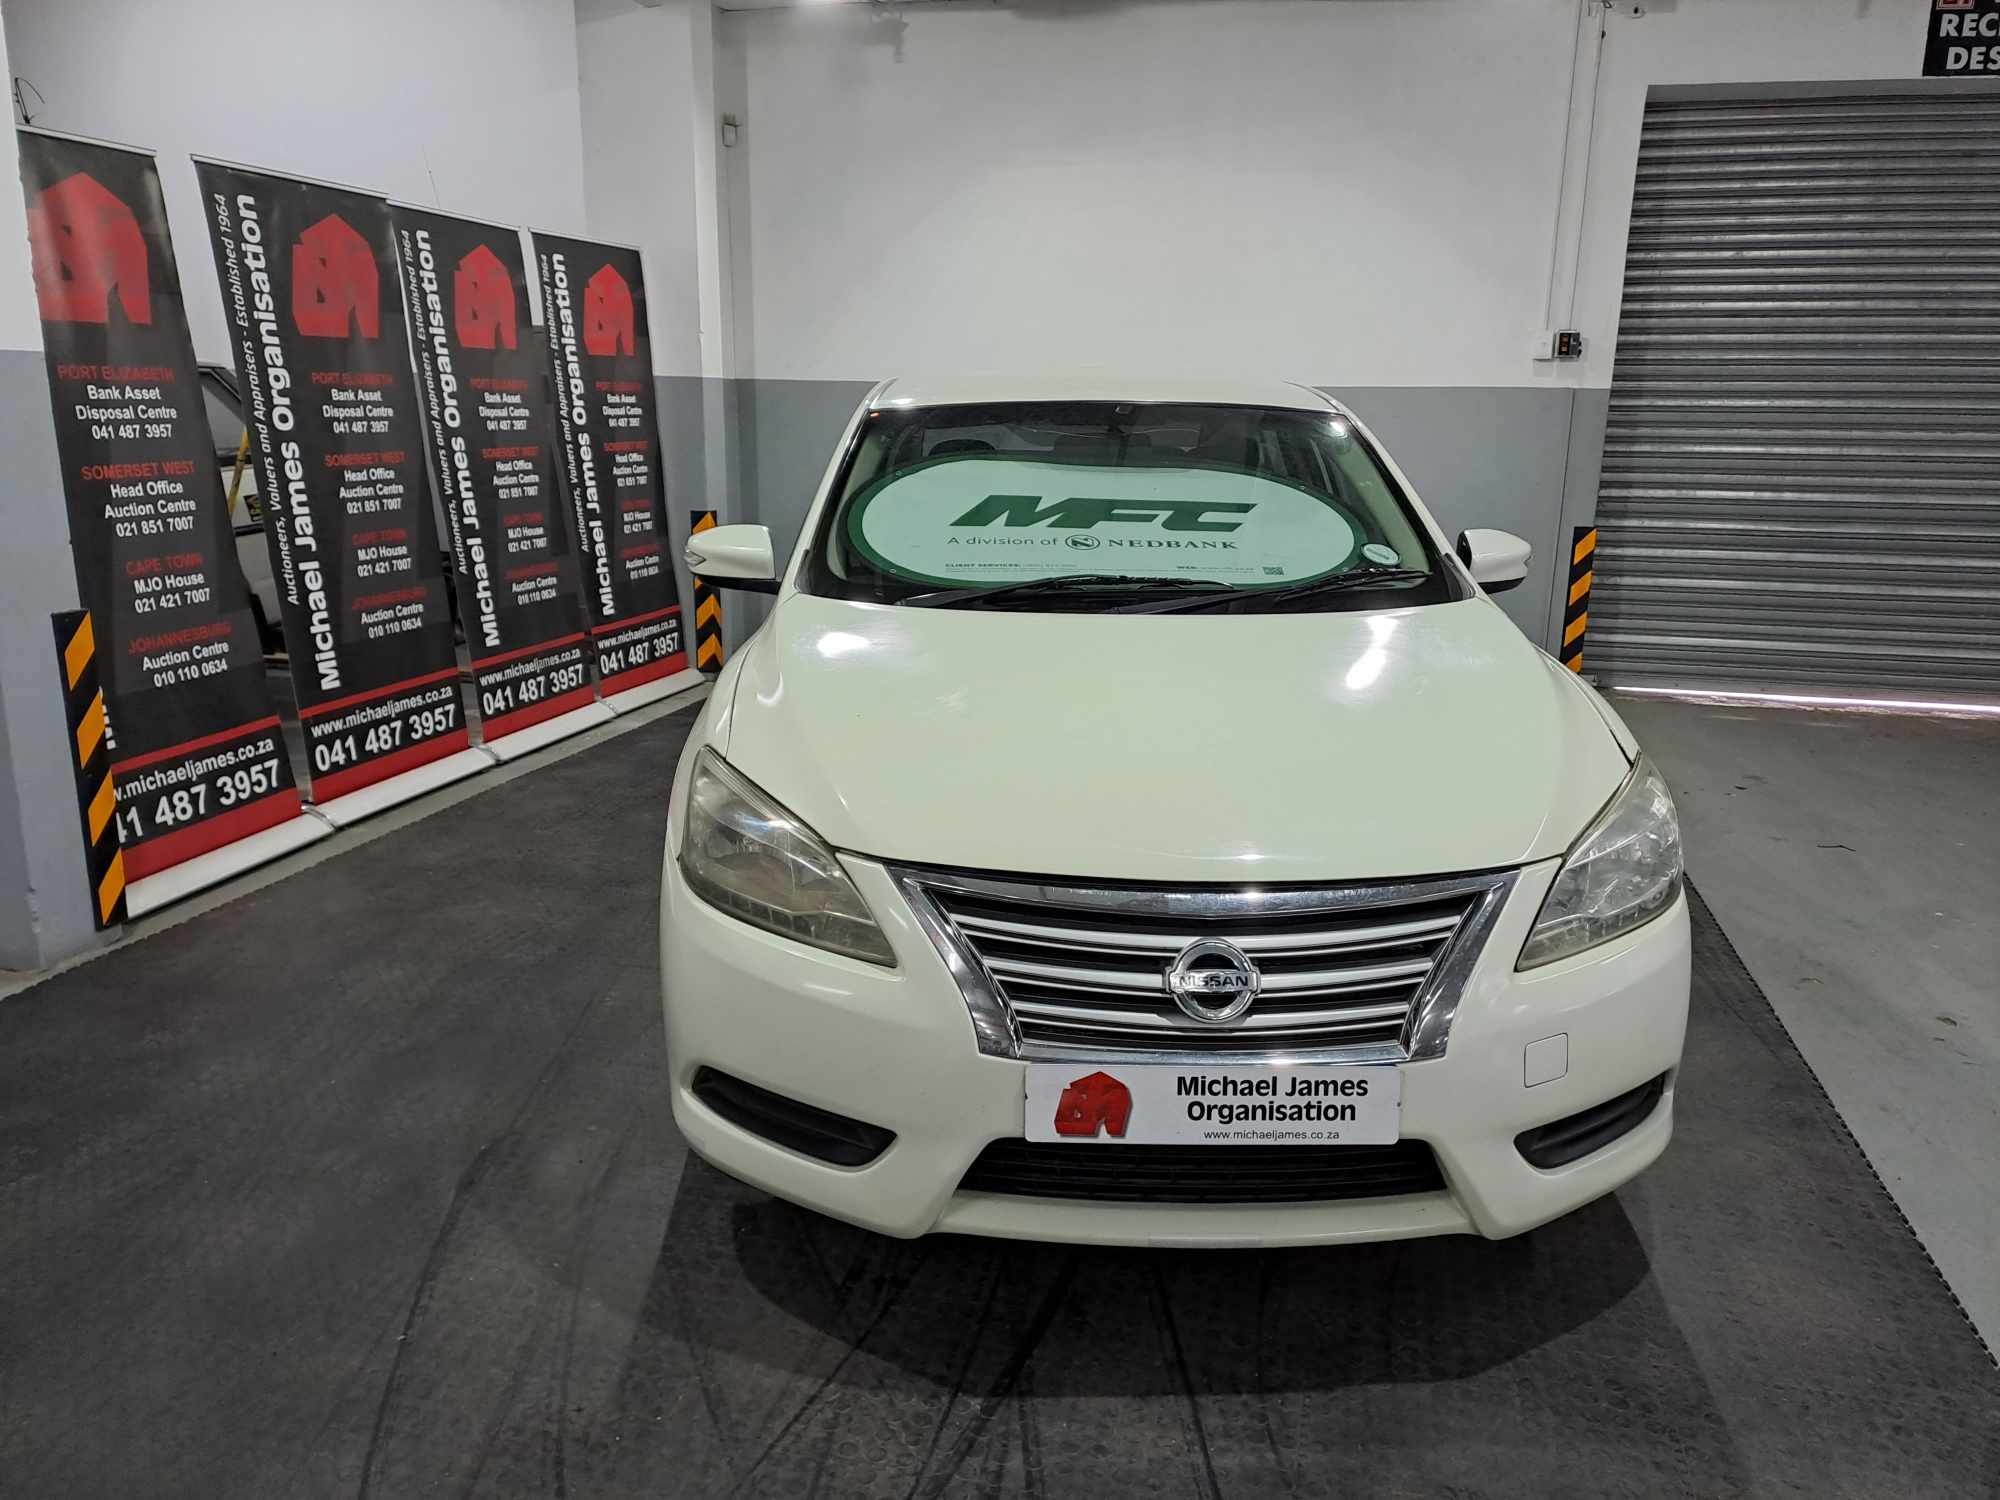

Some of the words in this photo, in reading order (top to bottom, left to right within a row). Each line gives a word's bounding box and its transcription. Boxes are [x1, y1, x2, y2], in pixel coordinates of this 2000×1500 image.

[1940, 12, 2000, 37] REC
[214, 193, 232, 233] 1964
[221, 237, 249, 328] Established
[237, 194, 295, 432] Organisation
[405, 265, 426, 340] Established
[416, 229, 461, 428] Organisation
[552, 253, 586, 425] Organisation
[57, 365, 97, 380] PORT
[243, 340, 266, 421] Appraisers
[87, 385, 121, 400] Bank
[124, 386, 161, 400] Asset
[331, 389, 356, 401] Bank
[357, 390, 382, 401] Asset
[75, 404, 134, 422] Disposal
[137, 405, 177, 419] Centre
[323, 406, 364, 419] Disposal
[366, 406, 394, 418] Centre
[91, 425, 114, 439] 041
[118, 425, 139, 439] 487
[145, 424, 172, 438] 3957
[255, 423, 271, 453] and
[333, 422, 349, 433] 041
[351, 422, 367, 433] 487
[370, 421, 388, 432] 3957
[432, 421, 444, 446] and
[80, 463, 158, 480] SOMERSET
[161, 460, 195, 475] WEST
[344, 470, 367, 483] Head
[369, 468, 395, 480] Office
[439, 449, 454, 495] Valuers
[578, 432, 600, 514] James
[110, 483, 143, 498] Head
[146, 480, 183, 495] Office
[264, 457, 282, 510] Valuers
[339, 486, 374, 499] Auction
[376, 484, 404, 496] Centre
[451, 436, 479, 530] James
[105, 502, 153, 518] Auction
[157, 499, 196, 515] Centre
[281, 441, 316, 552] James
[347, 502, 363, 514] 021
[365, 501, 380, 512] 851
[949, 494, 1258, 532] MFC
[116, 522, 137, 537] 021
[141, 519, 164, 534] 851
[167, 516, 193, 532] 7007
[358, 549, 377, 561] MJO
[380, 545, 407, 558] House
[947, 537, 960, 545] A
[966, 536, 1034, 545] division
[1040, 537, 1058, 545] of
[1108, 538, 1238, 550] NEDBANK
[275, 516, 300, 605] Auctioneers,
[357, 565, 373, 577] 021
[375, 562, 390, 574] 421
[392, 558, 411, 571] 7007
[589, 520, 615, 616] Michael
[134, 577, 162, 595] MJO
[166, 573, 204, 589] House
[466, 537, 500, 647] Michael
[135, 599, 156, 613] 021
[160, 594, 181, 609] 421
[185, 588, 210, 604] 7007
[299, 561, 341, 691] Michael
[361, 610, 394, 625] Auction
[396, 602, 424, 617] Centre
[368, 626, 383, 639] 010
[385, 622, 400, 634] 110
[143, 651, 190, 671] Auction
[192, 641, 229, 660] Centre
[600, 650, 625, 674] 041
[628, 642, 649, 665] 487
[653, 632, 678, 657] 3957
[154, 672, 175, 688] 010
[177, 665, 199, 682] 110
[202, 659, 227, 676] 0634
[480, 648, 581, 687] www.michaeljames.co.za
[482, 686, 514, 715] 041
[518, 675, 545, 702] 487
[550, 664, 583, 692] 3957
[311, 685, 453, 738] www.michaeljames.co.za
[315, 735, 358, 772] 041
[365, 720, 402, 754] 487
[409, 704, 455, 740] 3957
[155, 783, 207, 826] 487
[216, 758, 279, 806] 3957
[1178, 975, 1249, 987] NISSAN
[1177, 1076, 1278, 1097] Michael
[1285, 1076, 1369, 1097] James
[1187, 1101, 1357, 1124] Organisation
[1204, 1129, 1340, 1142] www.michaeljames.co.za
